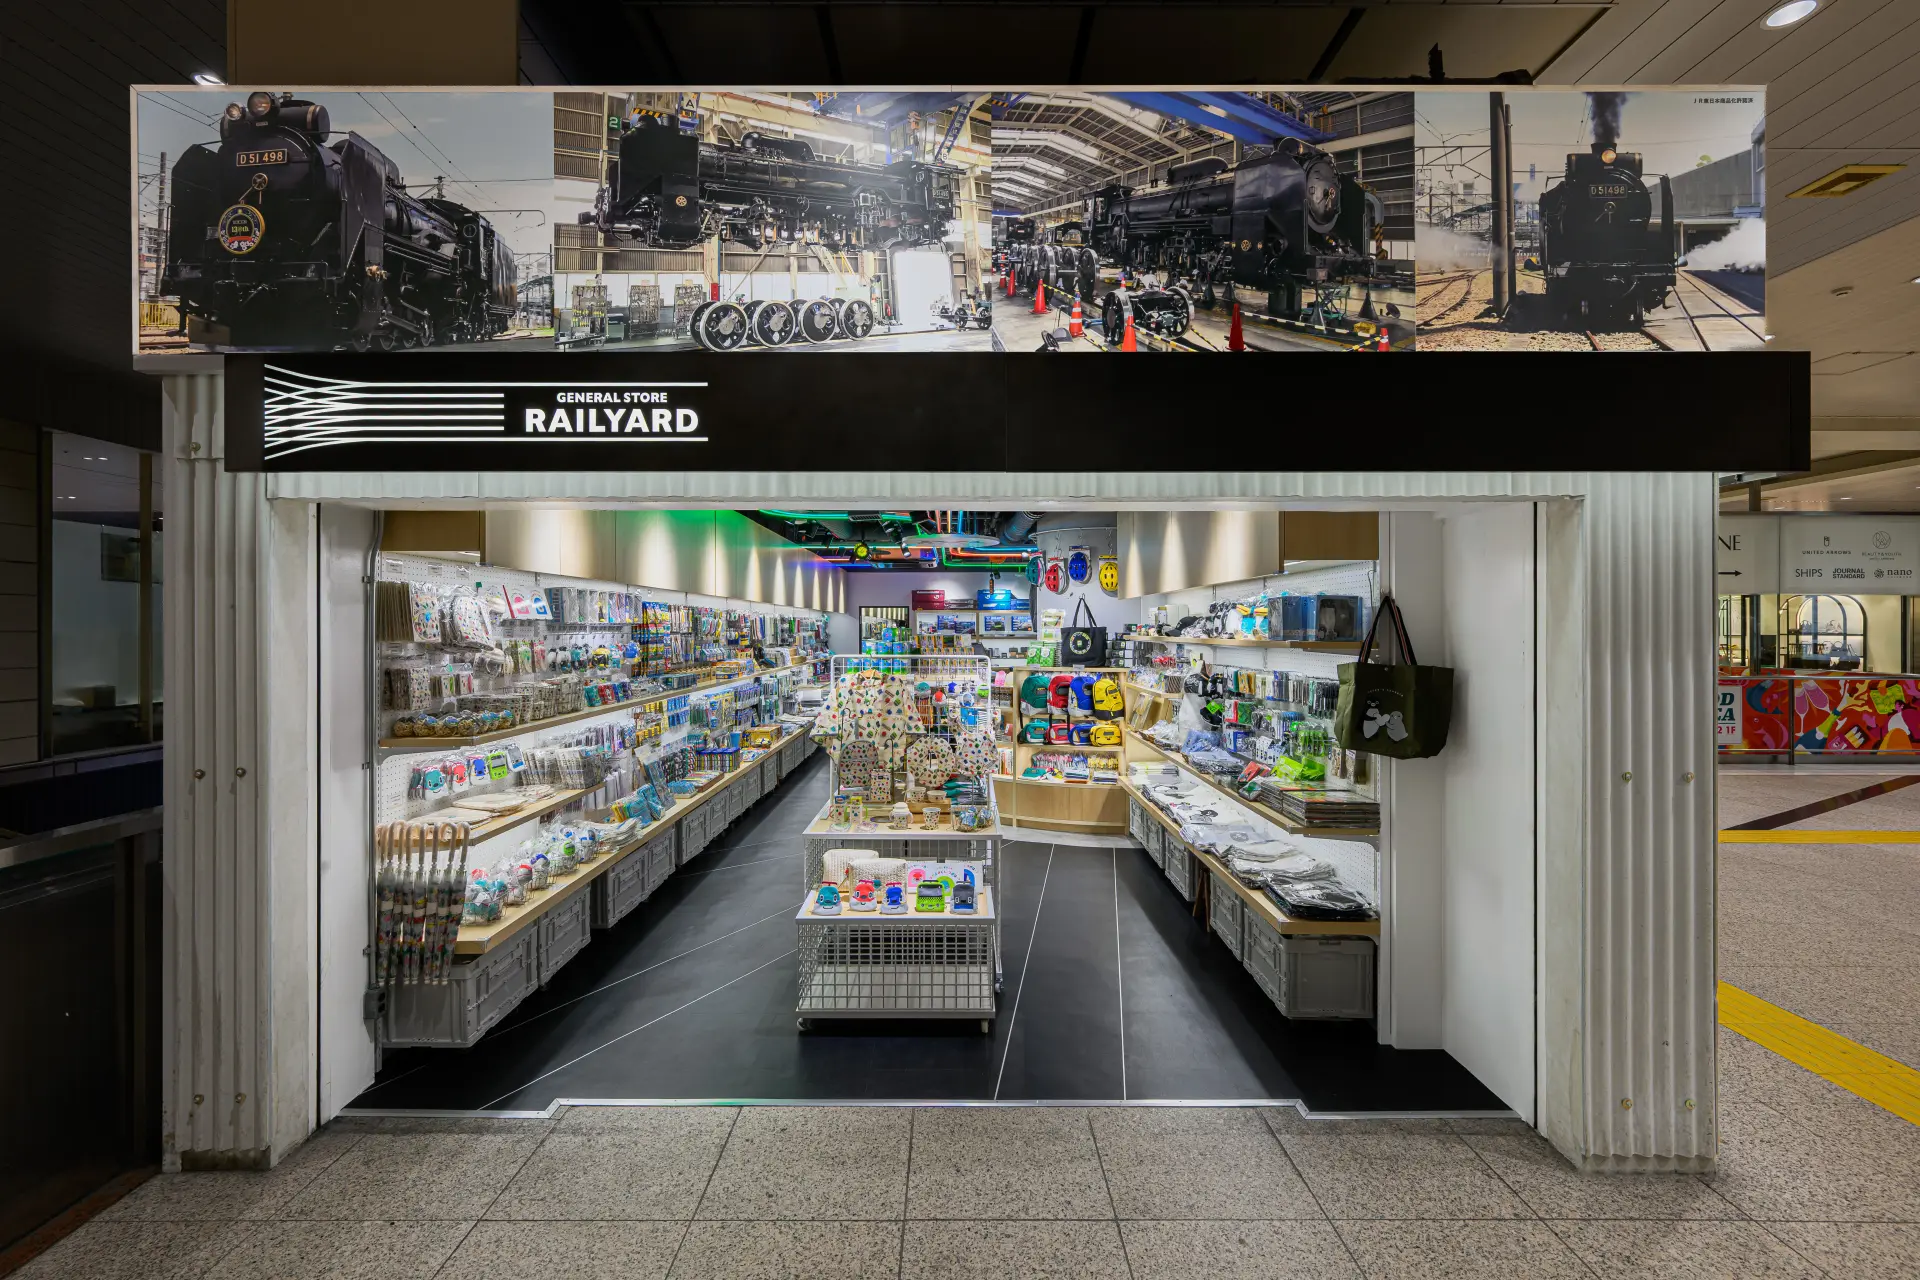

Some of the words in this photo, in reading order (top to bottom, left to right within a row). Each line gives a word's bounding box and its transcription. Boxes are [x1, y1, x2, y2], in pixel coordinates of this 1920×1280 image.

[686, 100, 694, 108] A
[609, 117, 618, 128] 2
[556, 392, 621, 403] GENERAL
[623, 392, 668, 403] STORE
[525, 408, 699, 433] RAILYARD
[1795, 568, 1823, 578] SHIPS
[1886, 568, 1913, 576] nano
[1718, 693, 1734, 705] D
[1726, 726, 1736, 734] 1F
